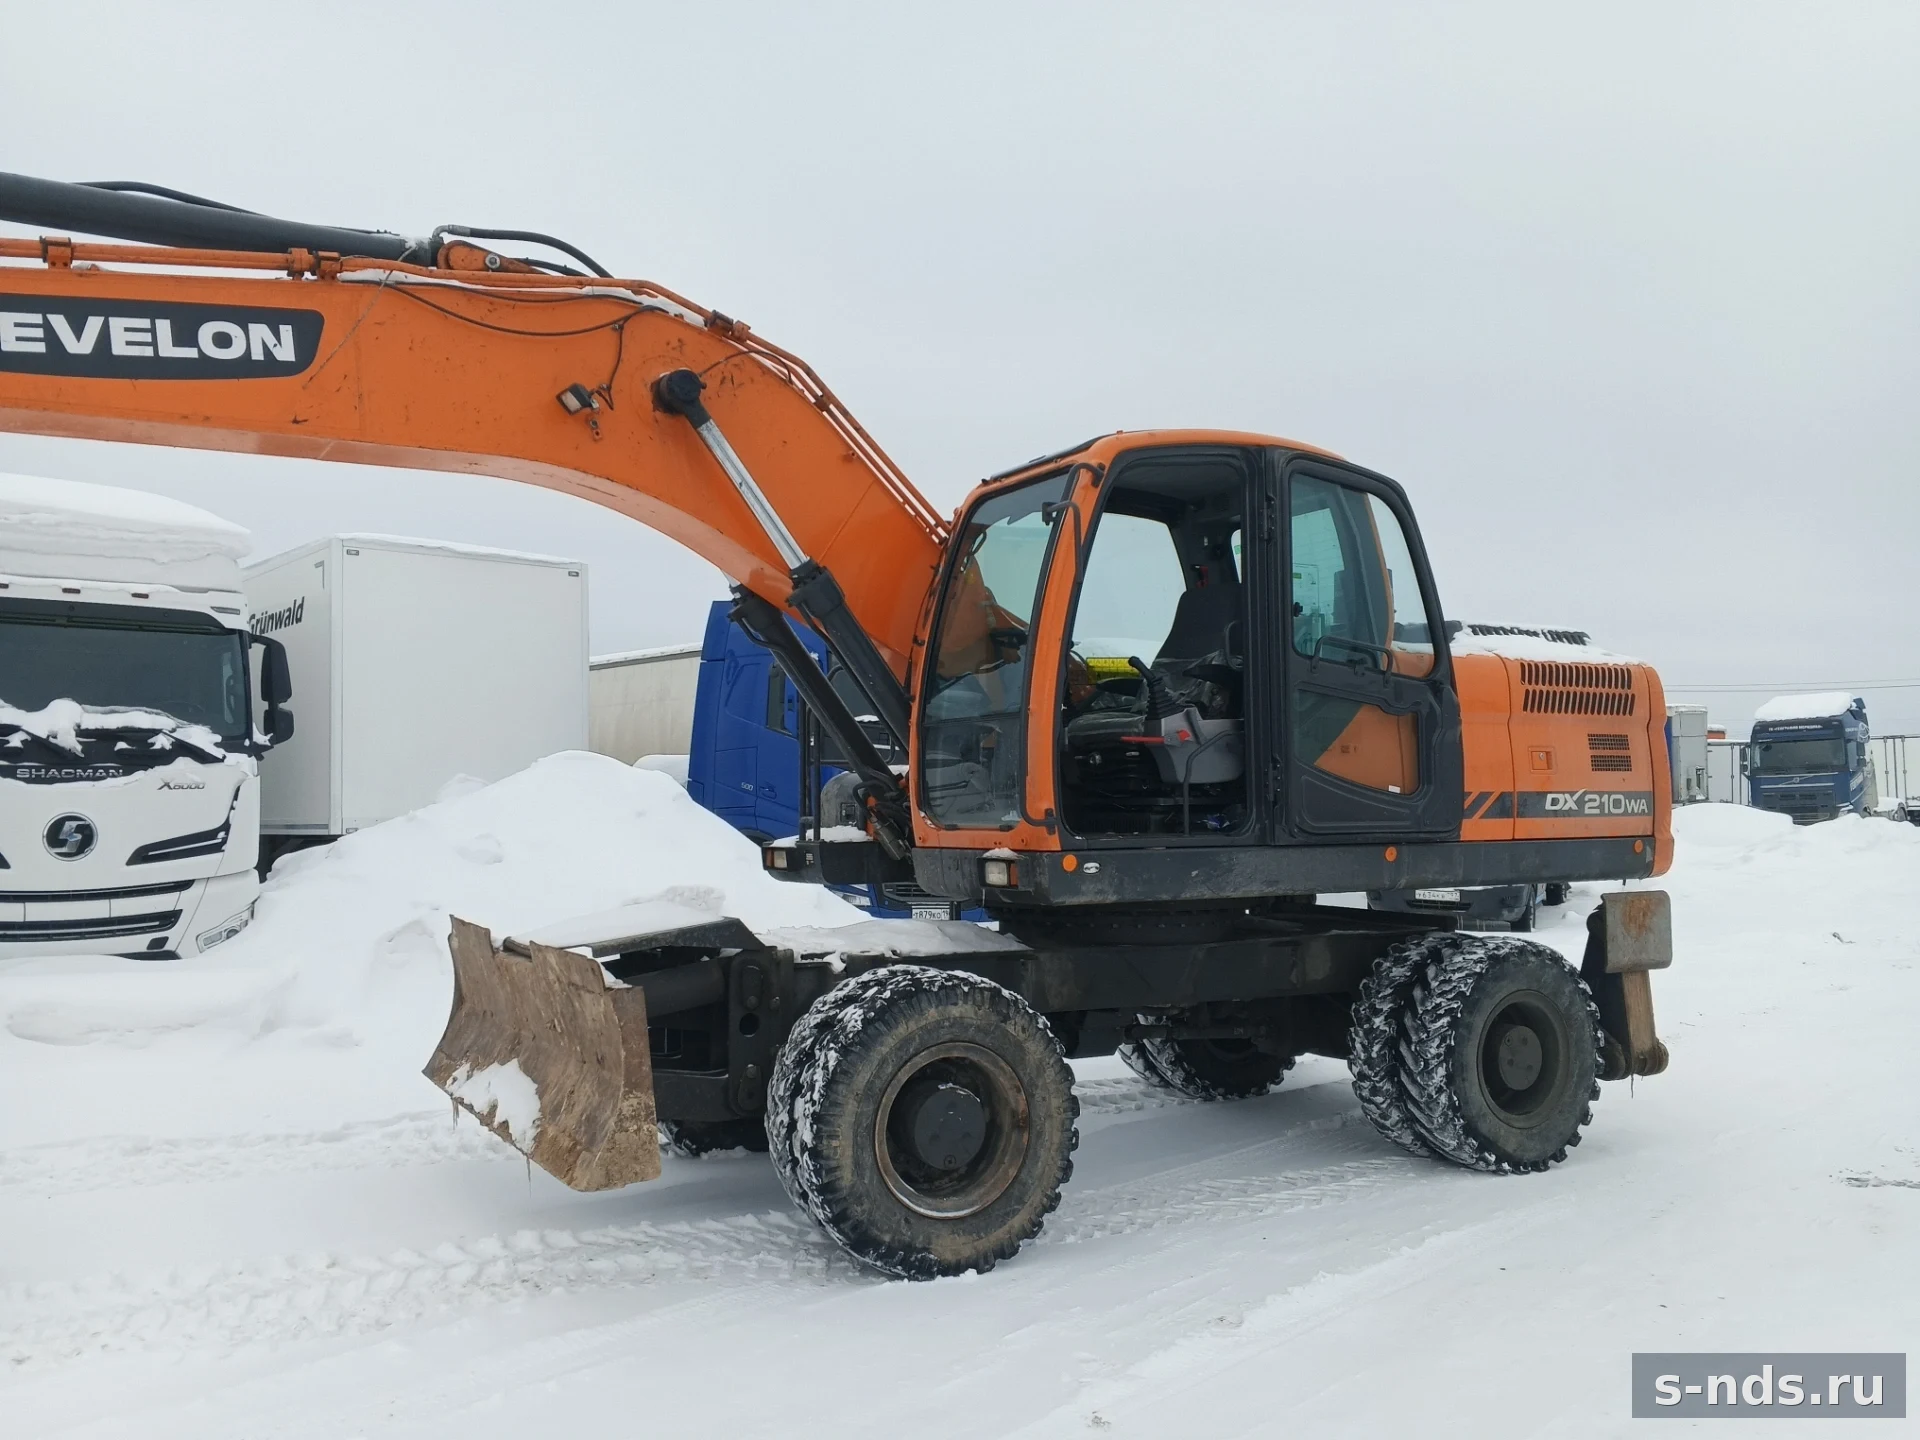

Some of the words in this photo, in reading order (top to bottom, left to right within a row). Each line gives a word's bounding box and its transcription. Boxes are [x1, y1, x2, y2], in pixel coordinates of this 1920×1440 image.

[0, 311, 296, 362] EVELON
[248, 596, 305, 635] Grünwald
[16, 768, 123, 779] SHACMAN
